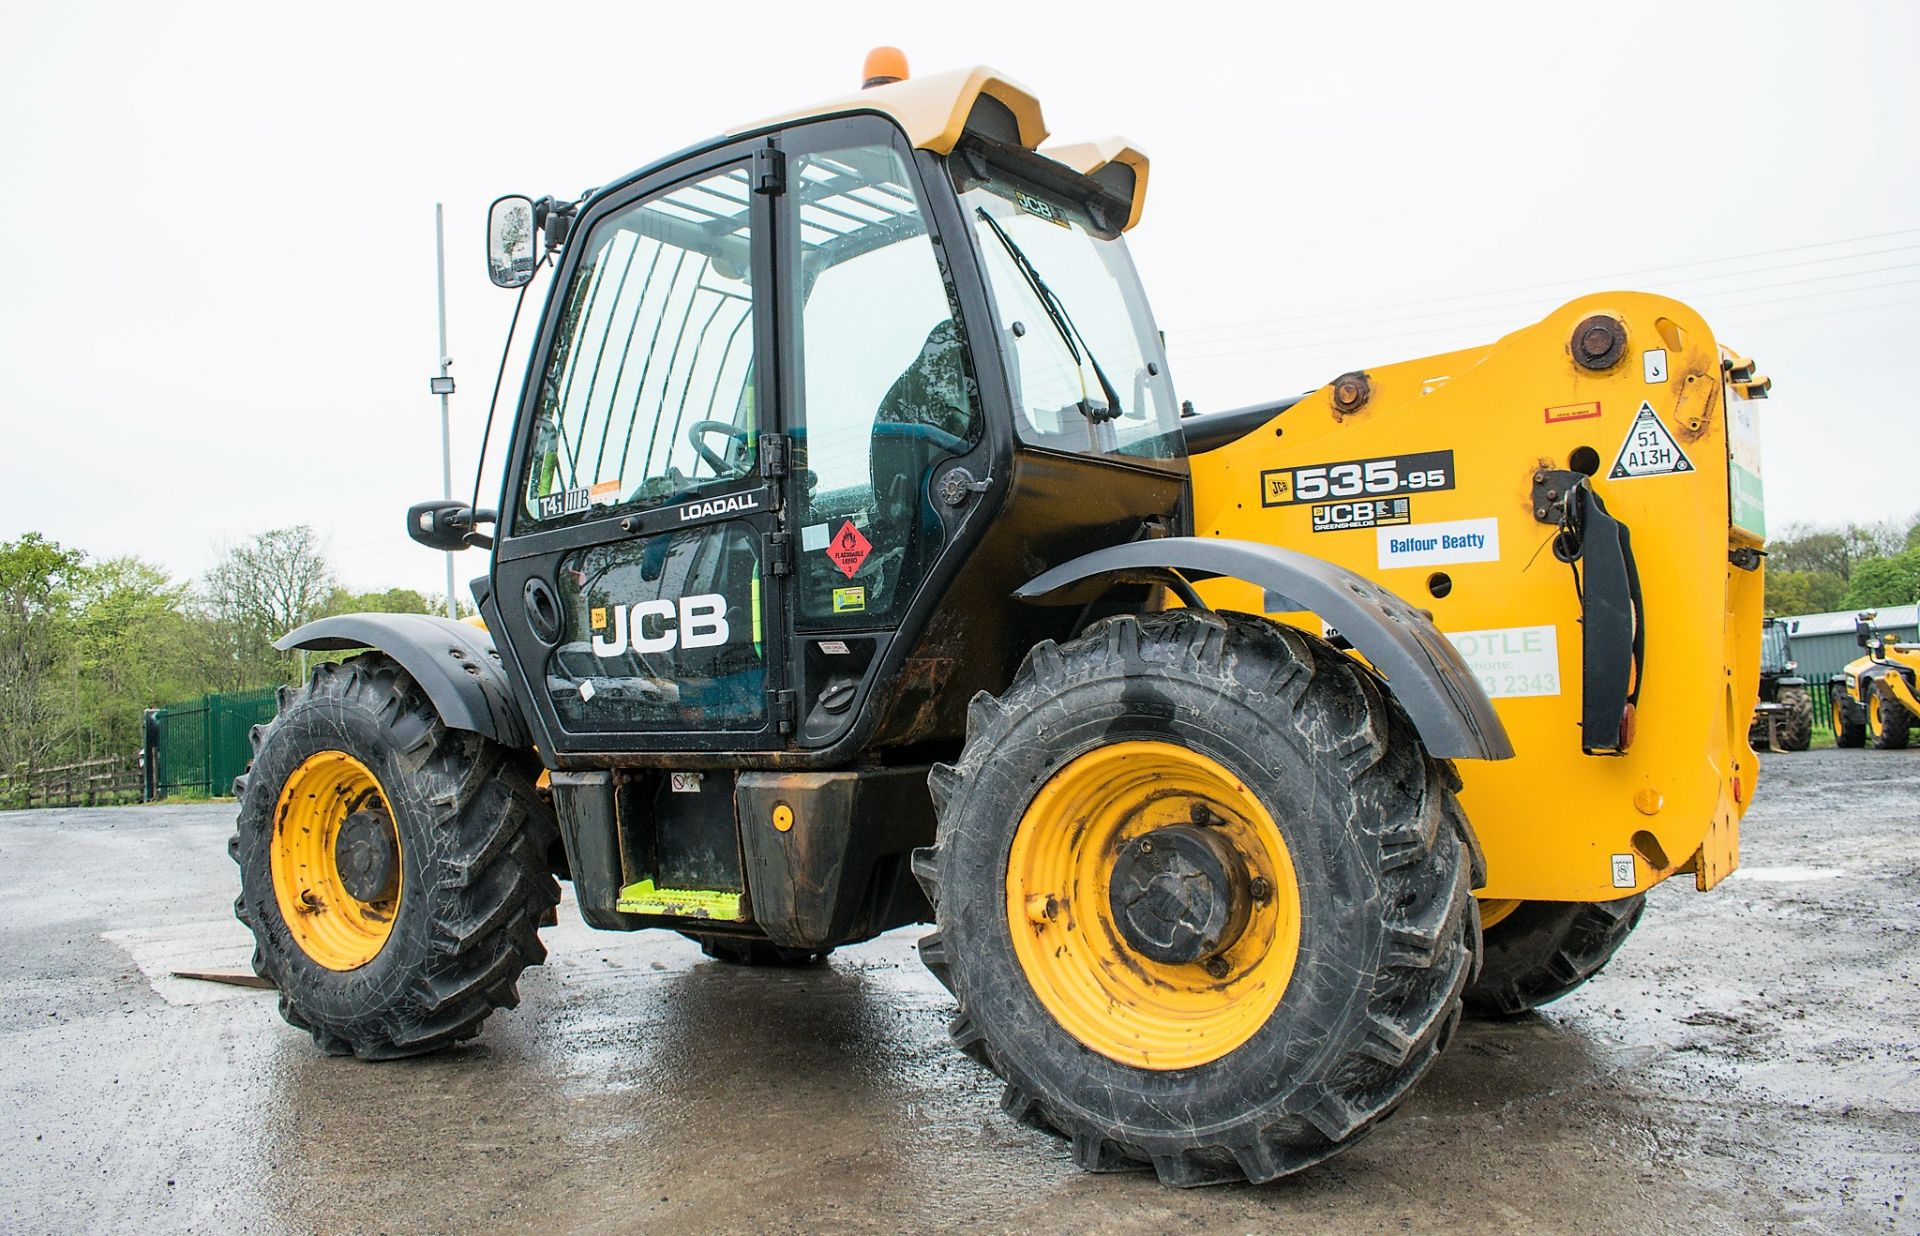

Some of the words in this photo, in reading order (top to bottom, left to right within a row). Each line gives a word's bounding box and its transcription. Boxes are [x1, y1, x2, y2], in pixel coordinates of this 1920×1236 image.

[1020, 193, 1053, 218] JCB
[1638, 431, 1659, 447] 51
[1272, 479, 1288, 494] JCB
[680, 494, 758, 521] LOADALL
[1313, 502, 1375, 524] JCB
[1314, 519, 1375, 531] GREENSHIELDS
[1390, 538, 1438, 554] Balfour
[1442, 533, 1485, 550] Beatty
[592, 593, 729, 658] JCB
[1457, 631, 1543, 656] OTLE
[1504, 673, 1555, 693] 2343
